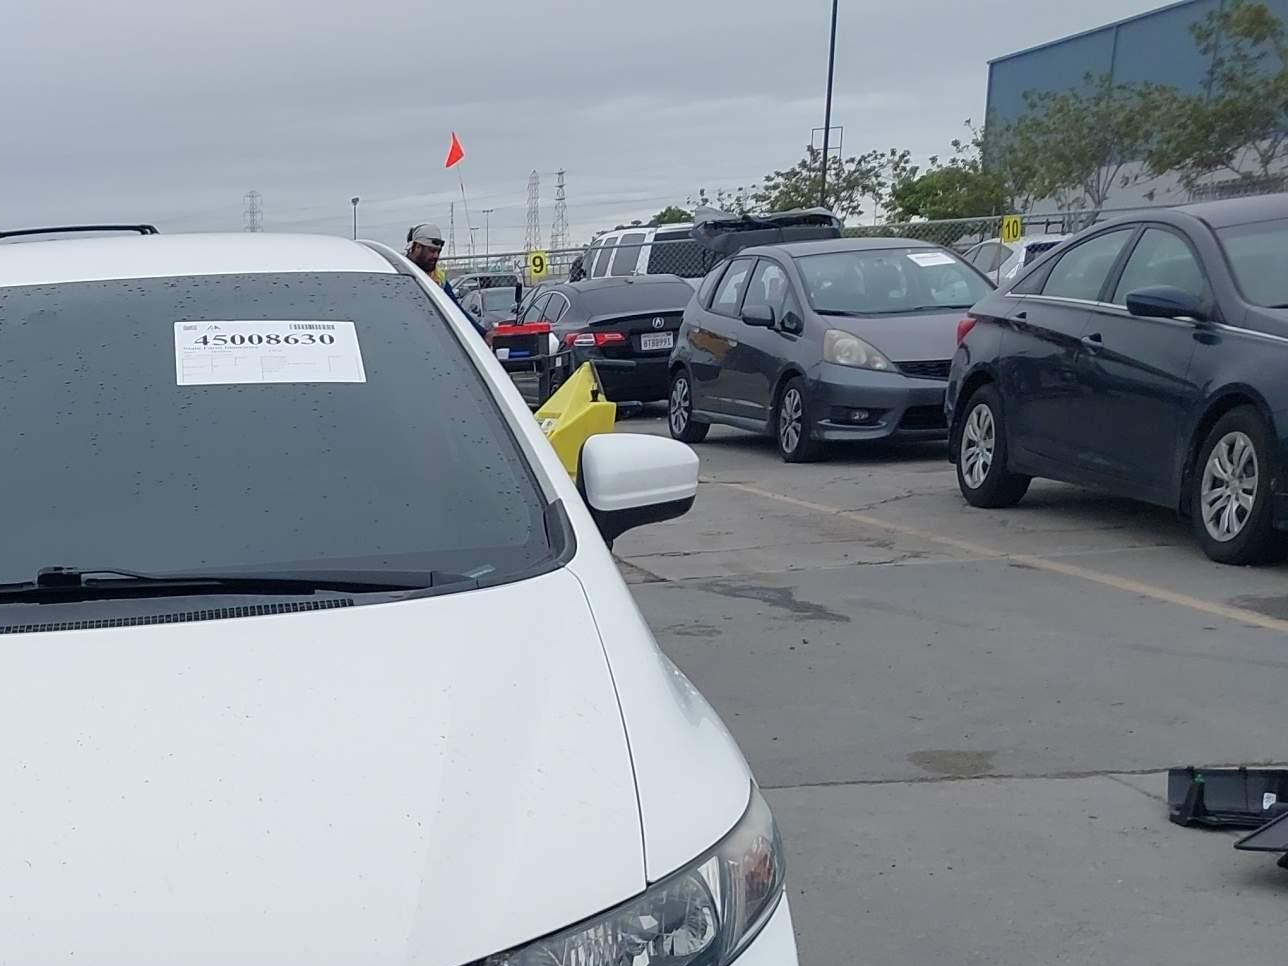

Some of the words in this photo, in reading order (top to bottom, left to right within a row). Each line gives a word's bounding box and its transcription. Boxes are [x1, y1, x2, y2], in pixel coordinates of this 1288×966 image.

[1006, 219, 1019, 239] 10
[532, 255, 544, 273] 9
[194, 333, 336, 346] 45008630
